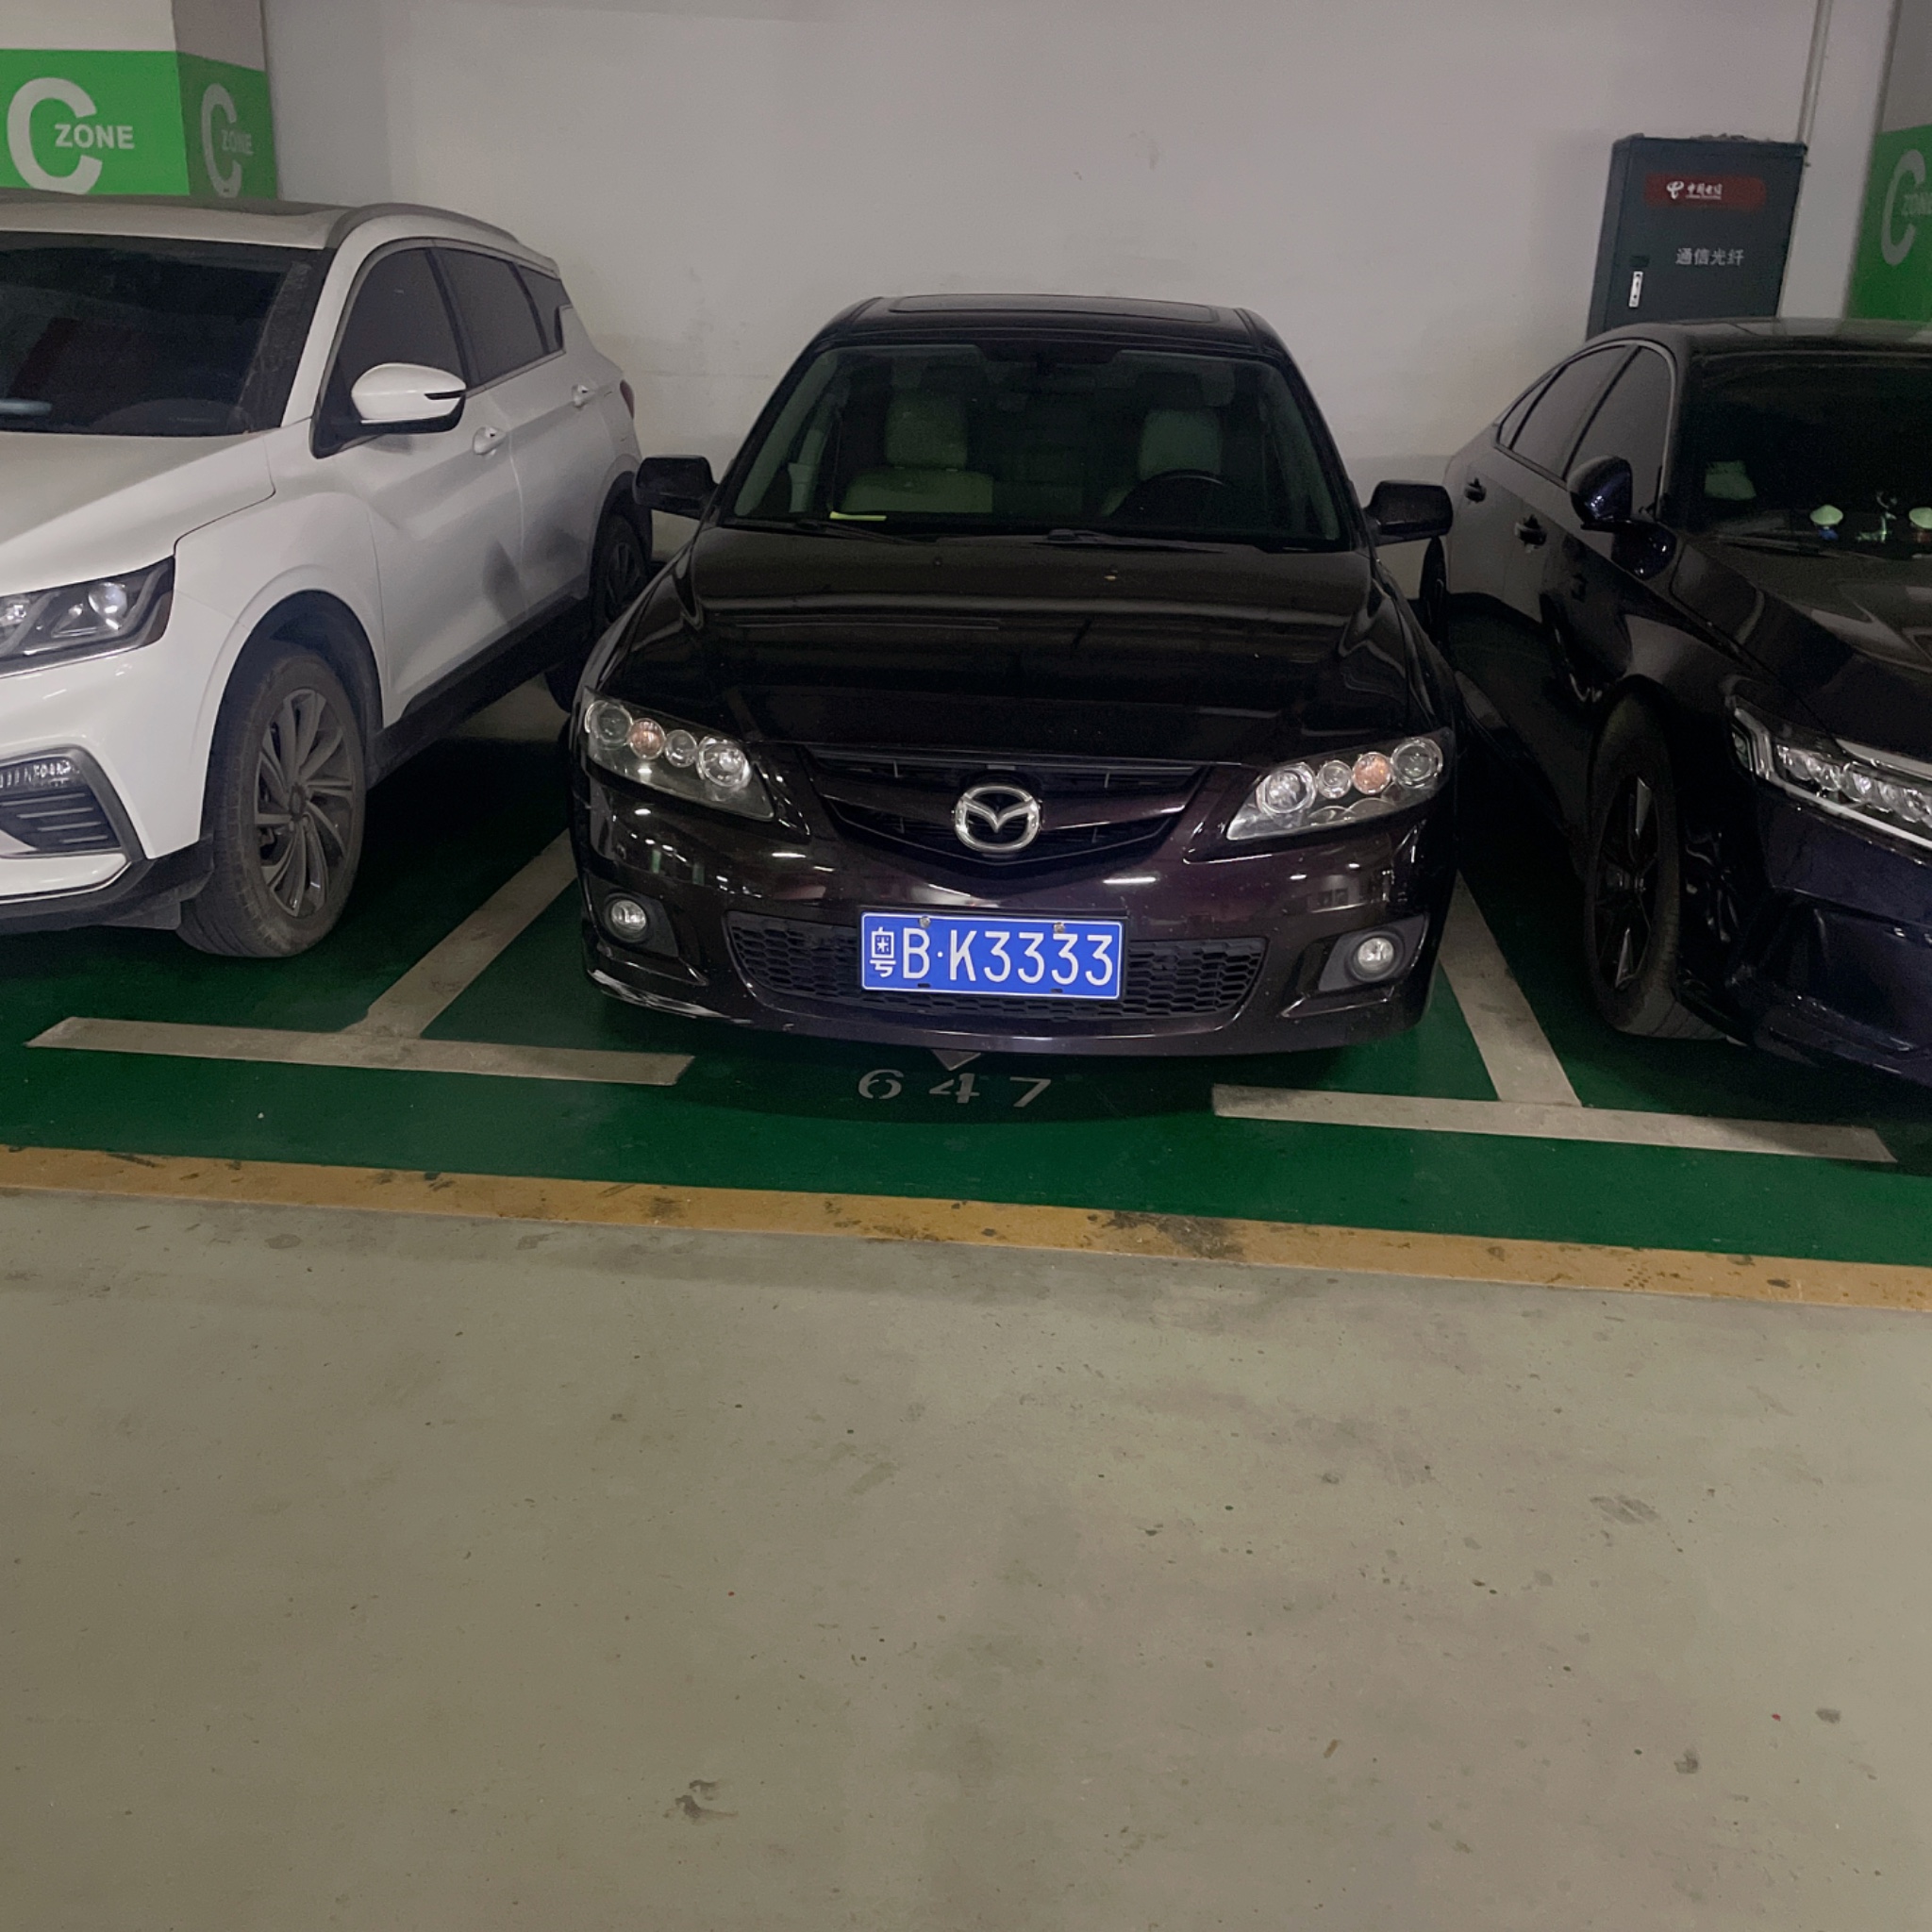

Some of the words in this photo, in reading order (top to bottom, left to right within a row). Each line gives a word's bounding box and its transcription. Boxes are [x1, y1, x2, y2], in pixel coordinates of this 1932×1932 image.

[7, 76, 103, 194] C
[54, 124, 135, 149] ZONE
[201, 83, 242, 198] C
[1881, 149, 1925, 266] C
[1675, 247, 1744, 266] 通信光纤
[858, 1069, 1052, 1108] 647
